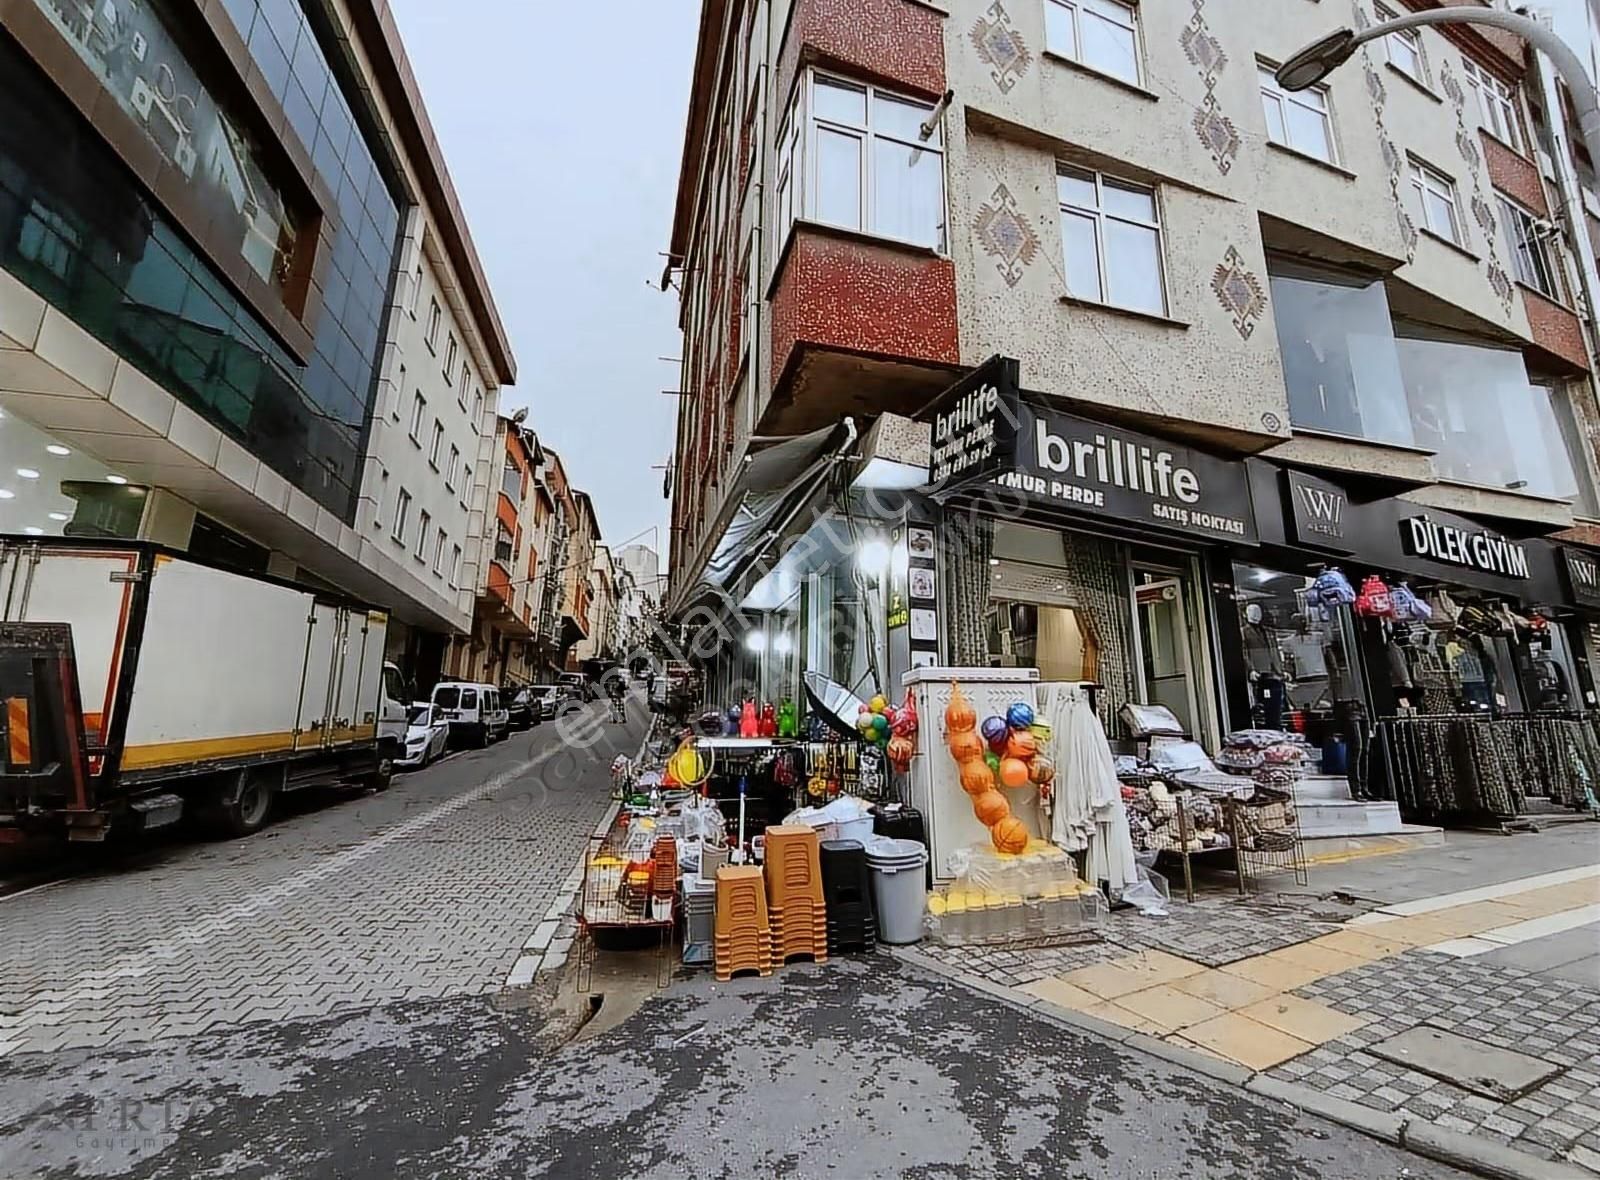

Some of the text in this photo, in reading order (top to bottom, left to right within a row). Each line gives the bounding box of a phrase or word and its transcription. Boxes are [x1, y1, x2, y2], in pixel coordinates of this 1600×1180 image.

[935, 383, 998, 442] brillife
[1036, 418, 1201, 504] brillife
[1051, 481, 1104, 507] PERDE
[1153, 503, 1244, 534] SATIŞ NOKTASI
[1410, 514, 1530, 579] DİLEK GİYİM
